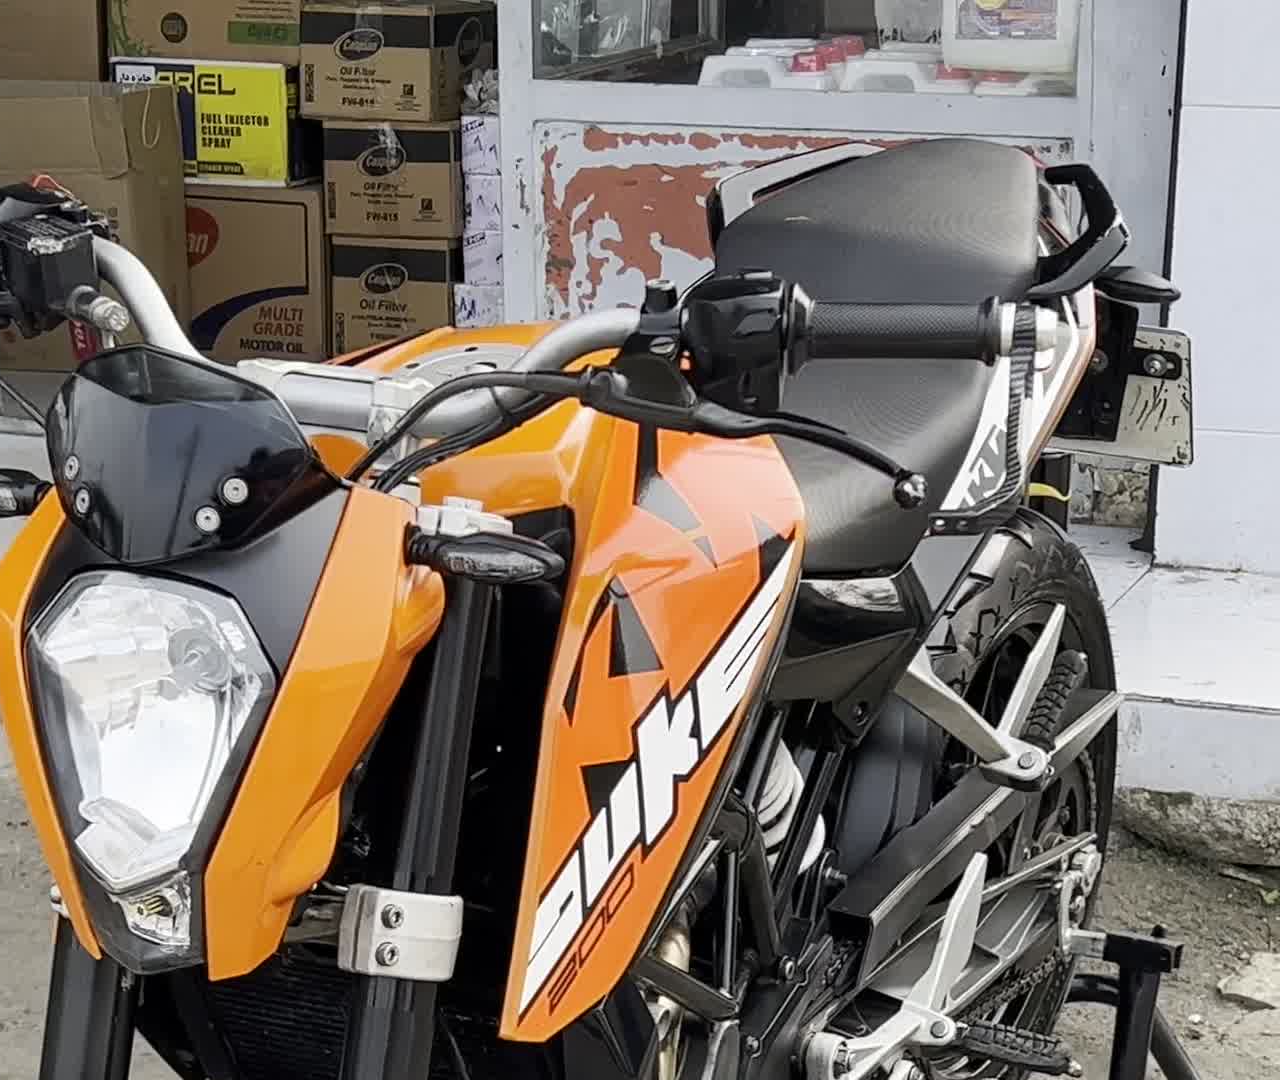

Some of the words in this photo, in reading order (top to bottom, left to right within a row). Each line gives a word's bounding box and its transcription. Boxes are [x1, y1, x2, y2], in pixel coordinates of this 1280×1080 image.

[200, 112, 222, 125] FUEL
[224, 113, 270, 127] INJECTOR
[200, 125, 242, 137] CLEANER
[201, 137, 232, 149] SPRAY
[359, 298, 376, 310] Oil
[377, 299, 408, 312] Filter
[258, 306, 304, 322] MULTI
[252, 321, 304, 337] GRADE
[239, 337, 285, 351] MOTOR
[286, 339, 304, 353] OIL
[546, 862, 635, 1016] 200
